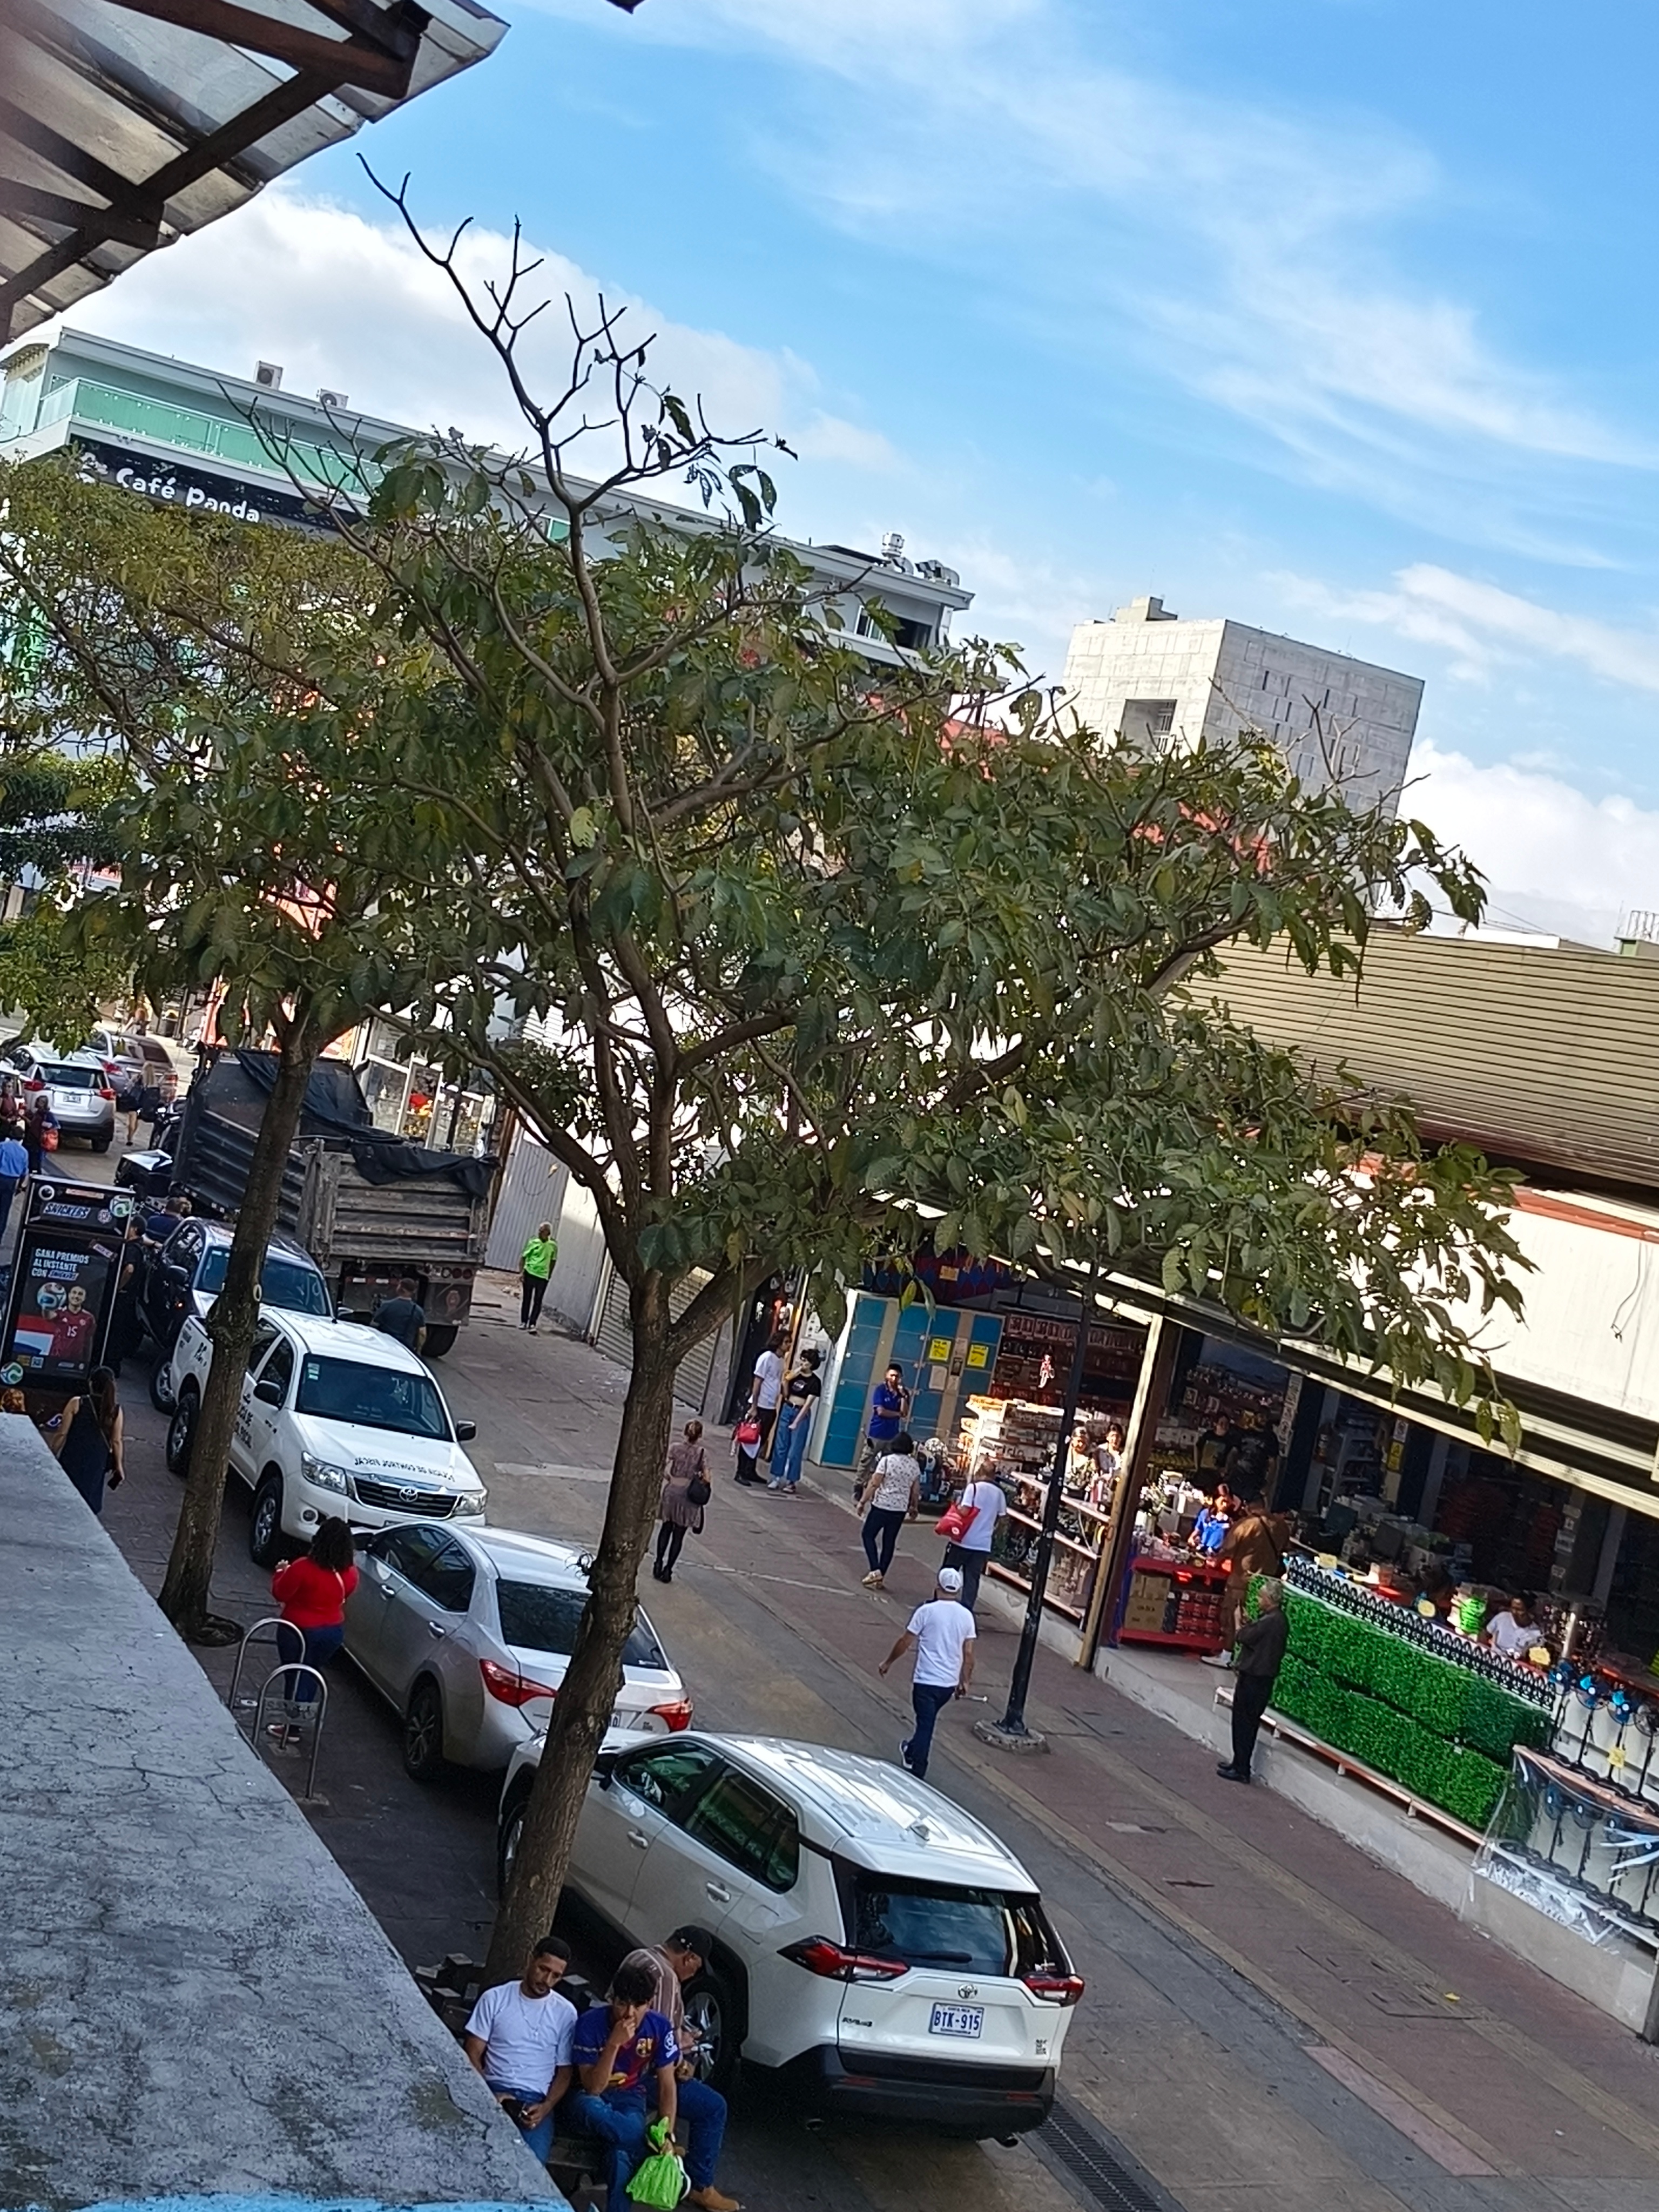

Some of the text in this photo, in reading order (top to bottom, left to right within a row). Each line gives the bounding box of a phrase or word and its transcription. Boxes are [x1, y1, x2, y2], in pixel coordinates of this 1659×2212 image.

[116, 468, 260, 523] Café Panda
[35, 1248, 55, 1259] GANA
[56, 1251, 90, 1264] PREMIOS
[31, 1267, 48, 1278] CON
[43, 1259, 77, 1272] INSTANTE
[67, 1326, 78, 1337] 15
[934, 2011, 980, 2031] BTK-915
